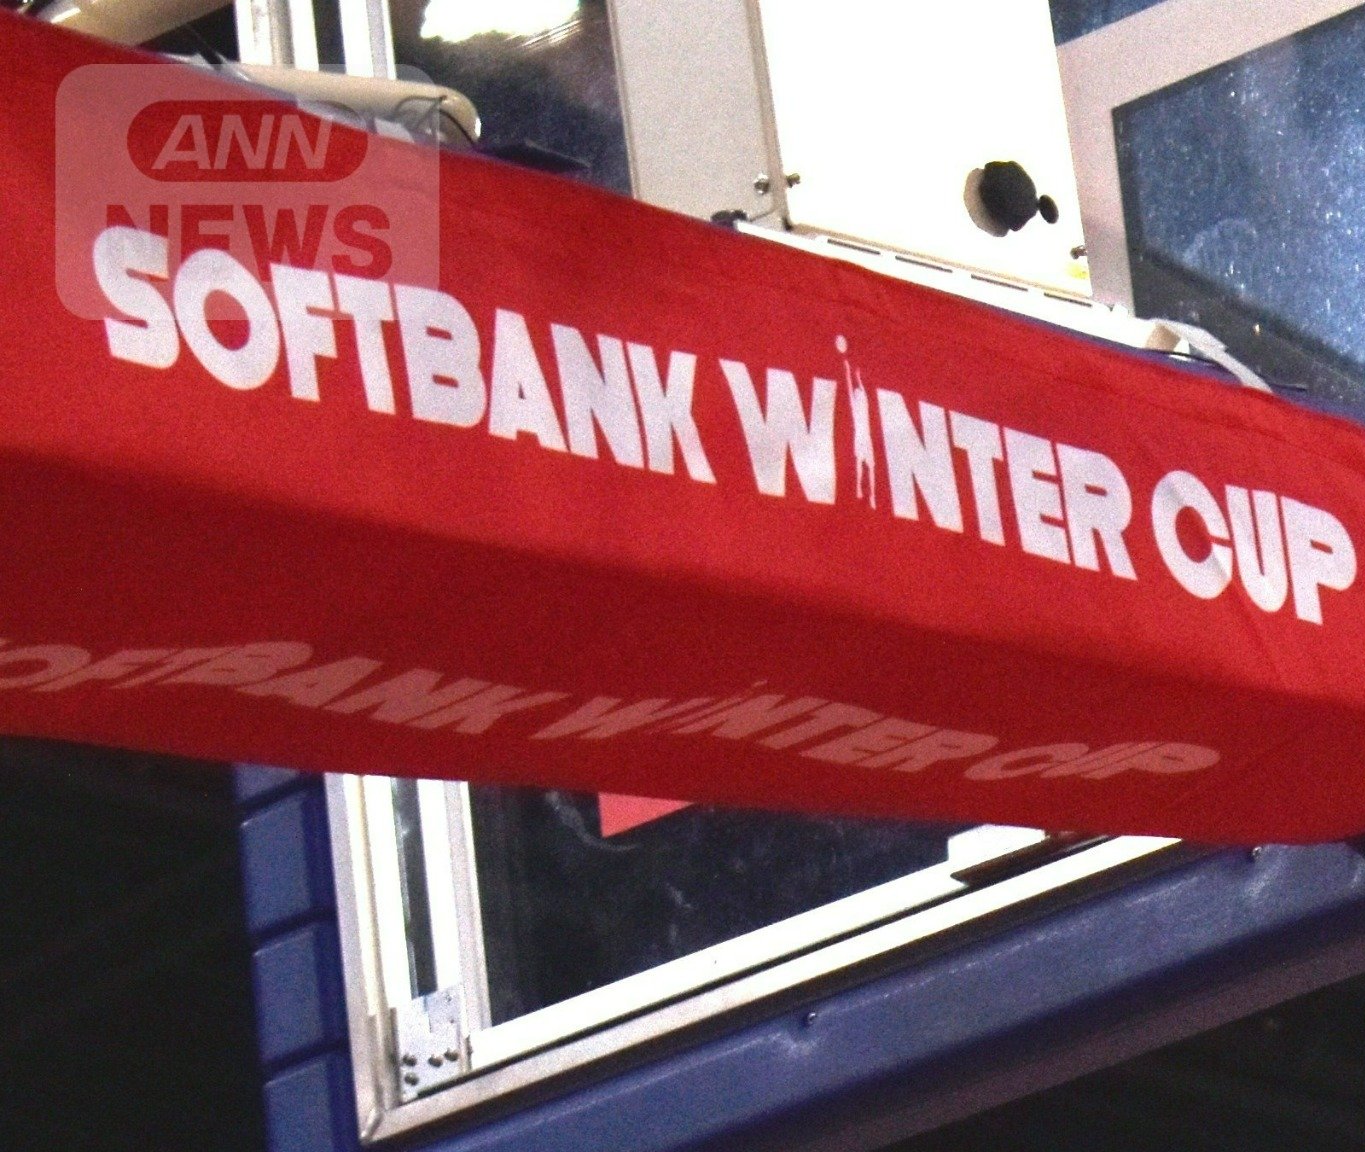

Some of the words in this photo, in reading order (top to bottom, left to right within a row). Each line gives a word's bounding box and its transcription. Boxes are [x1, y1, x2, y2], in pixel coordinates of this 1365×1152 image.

[93, 226, 717, 484] SOFTBANK
[719, 334, 1138, 580] WINTER
[1151, 469, 1358, 625] CUP
[0, 638, 572, 735] OFTBANK
[528, 680, 998, 773] WINTER
[963, 741, 1221, 780] CUP
